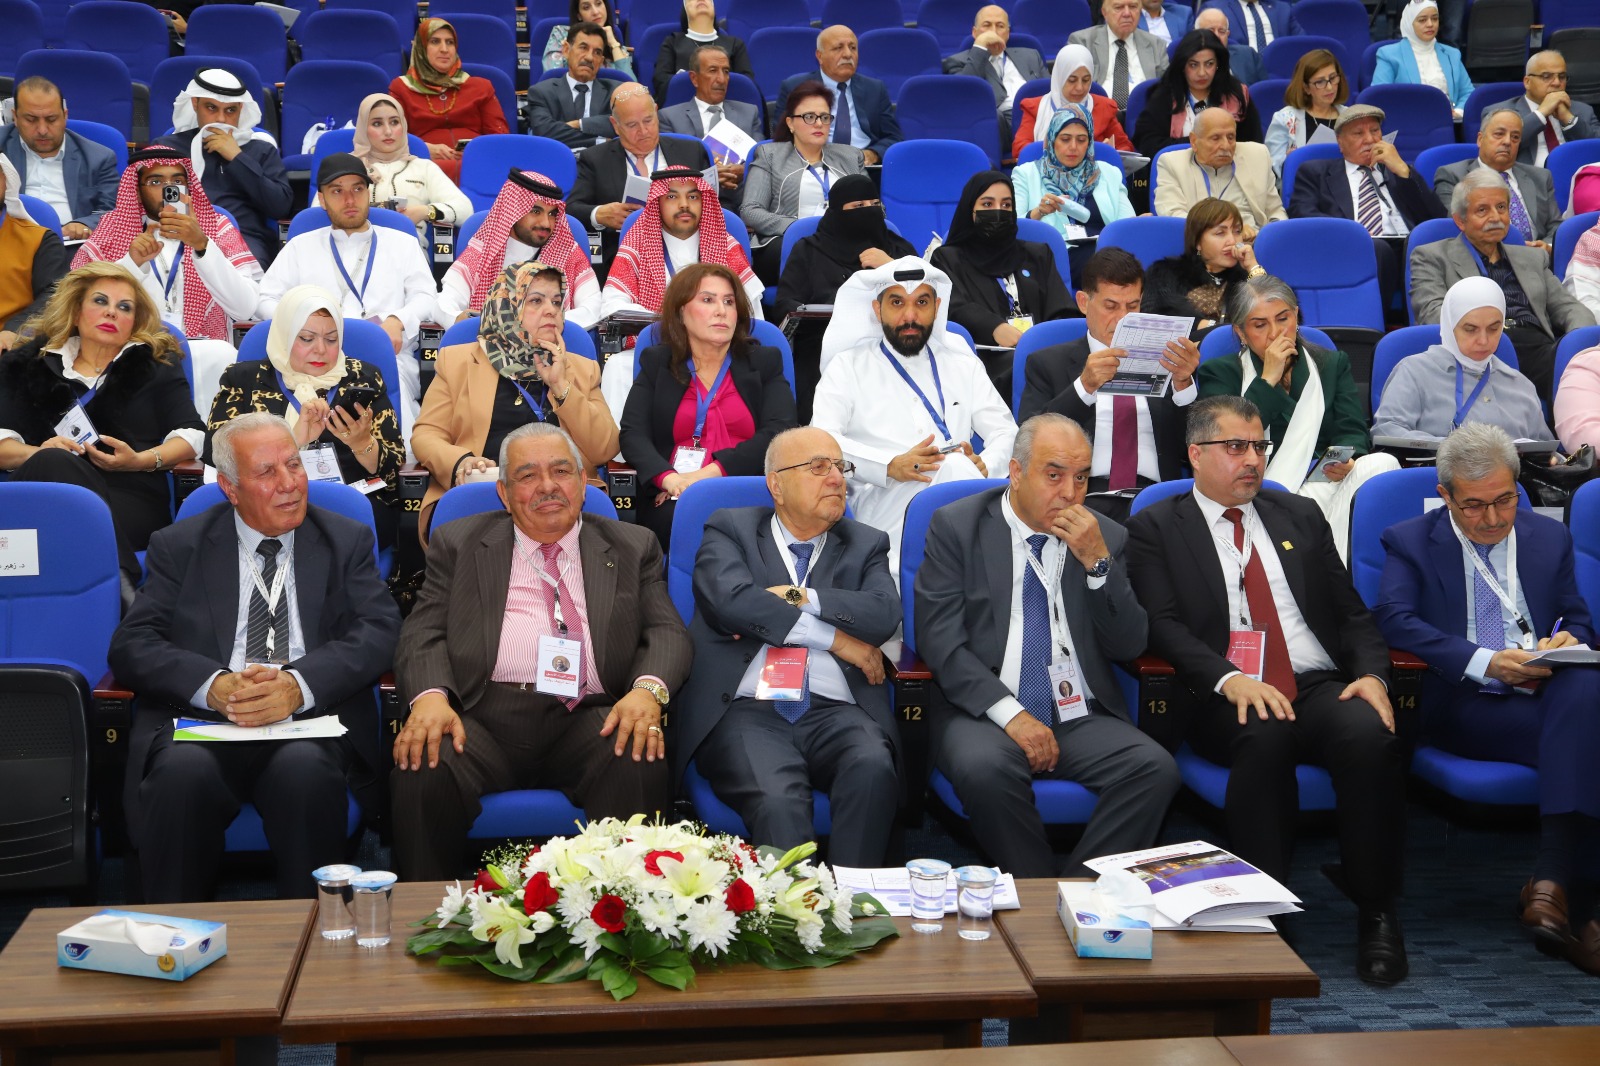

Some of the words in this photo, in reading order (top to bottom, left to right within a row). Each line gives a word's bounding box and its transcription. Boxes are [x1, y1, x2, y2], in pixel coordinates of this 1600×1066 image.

[1133, 179, 1148, 188] 104
[437, 244, 450, 254] 76
[424, 349, 438, 360] 54
[404, 499, 421, 511] 32
[615, 497, 632, 509] 33
[1148, 700, 1167, 714] 13
[1398, 695, 1416, 709] 14
[903, 706, 922, 721] 12
[106, 728, 117, 744] 9
